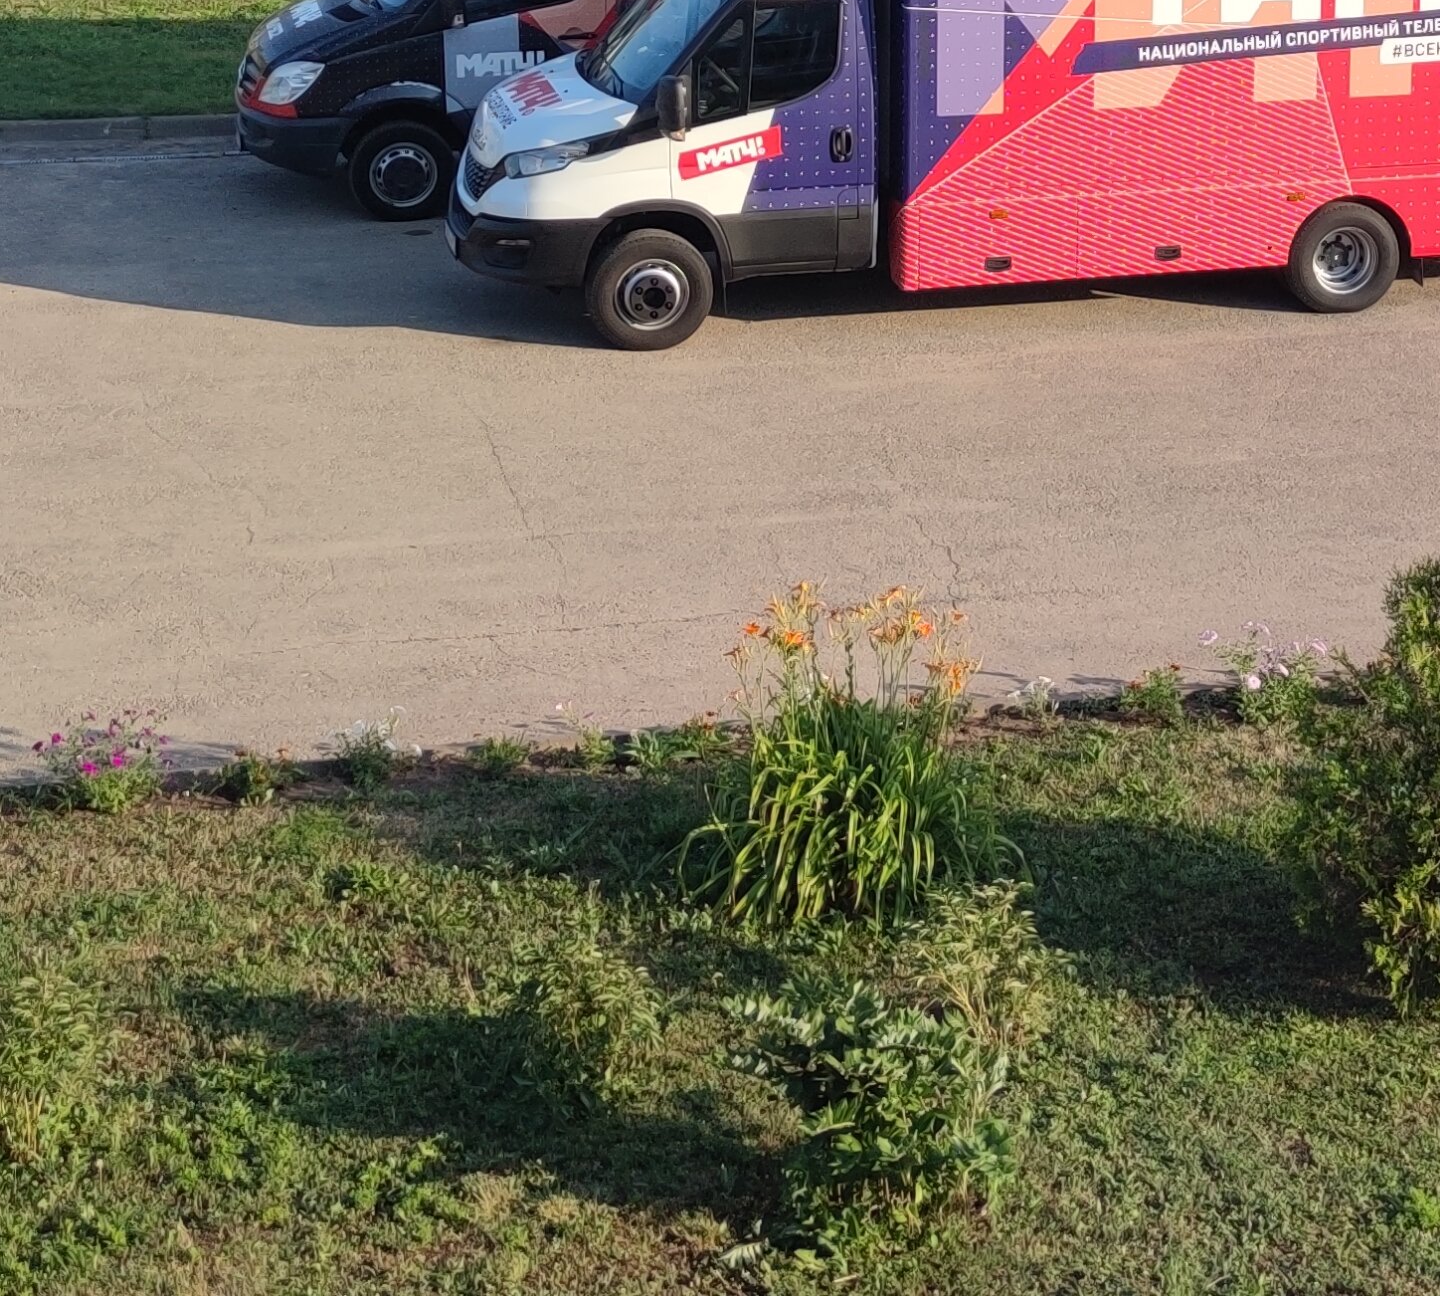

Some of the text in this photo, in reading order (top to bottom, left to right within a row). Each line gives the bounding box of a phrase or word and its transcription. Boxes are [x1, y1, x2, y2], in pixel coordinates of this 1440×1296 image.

[1138, 30, 1282, 62] НАЦИОНАЛЬНЫЙ
[1286, 19, 1399, 47] СПОРТИВНЫЙ
[696, 136, 766, 171] МАТЧ!
